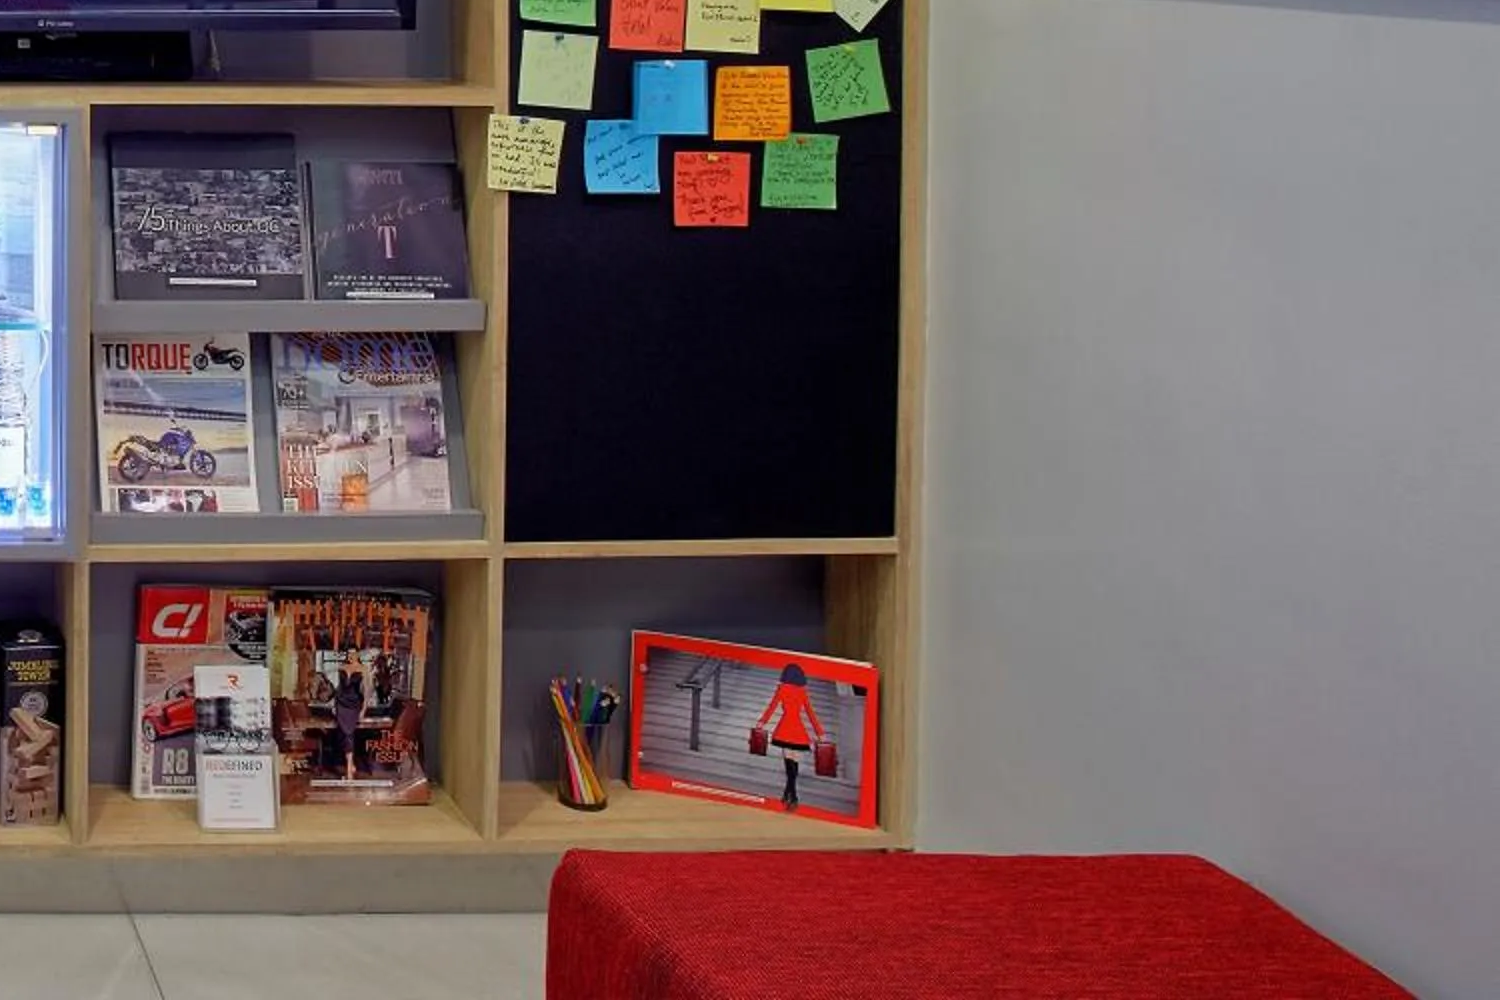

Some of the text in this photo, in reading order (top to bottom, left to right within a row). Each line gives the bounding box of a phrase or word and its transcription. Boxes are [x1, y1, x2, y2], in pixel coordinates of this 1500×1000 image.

[168, 219, 209, 234] Things
[213, 219, 252, 232] About
[101, 343, 192, 371] TORQUE
[152, 603, 204, 638] C!
[366, 739, 419, 751] FASHION
[162, 748, 189, 775] R8
[206, 759, 263, 771] REDEFINED
